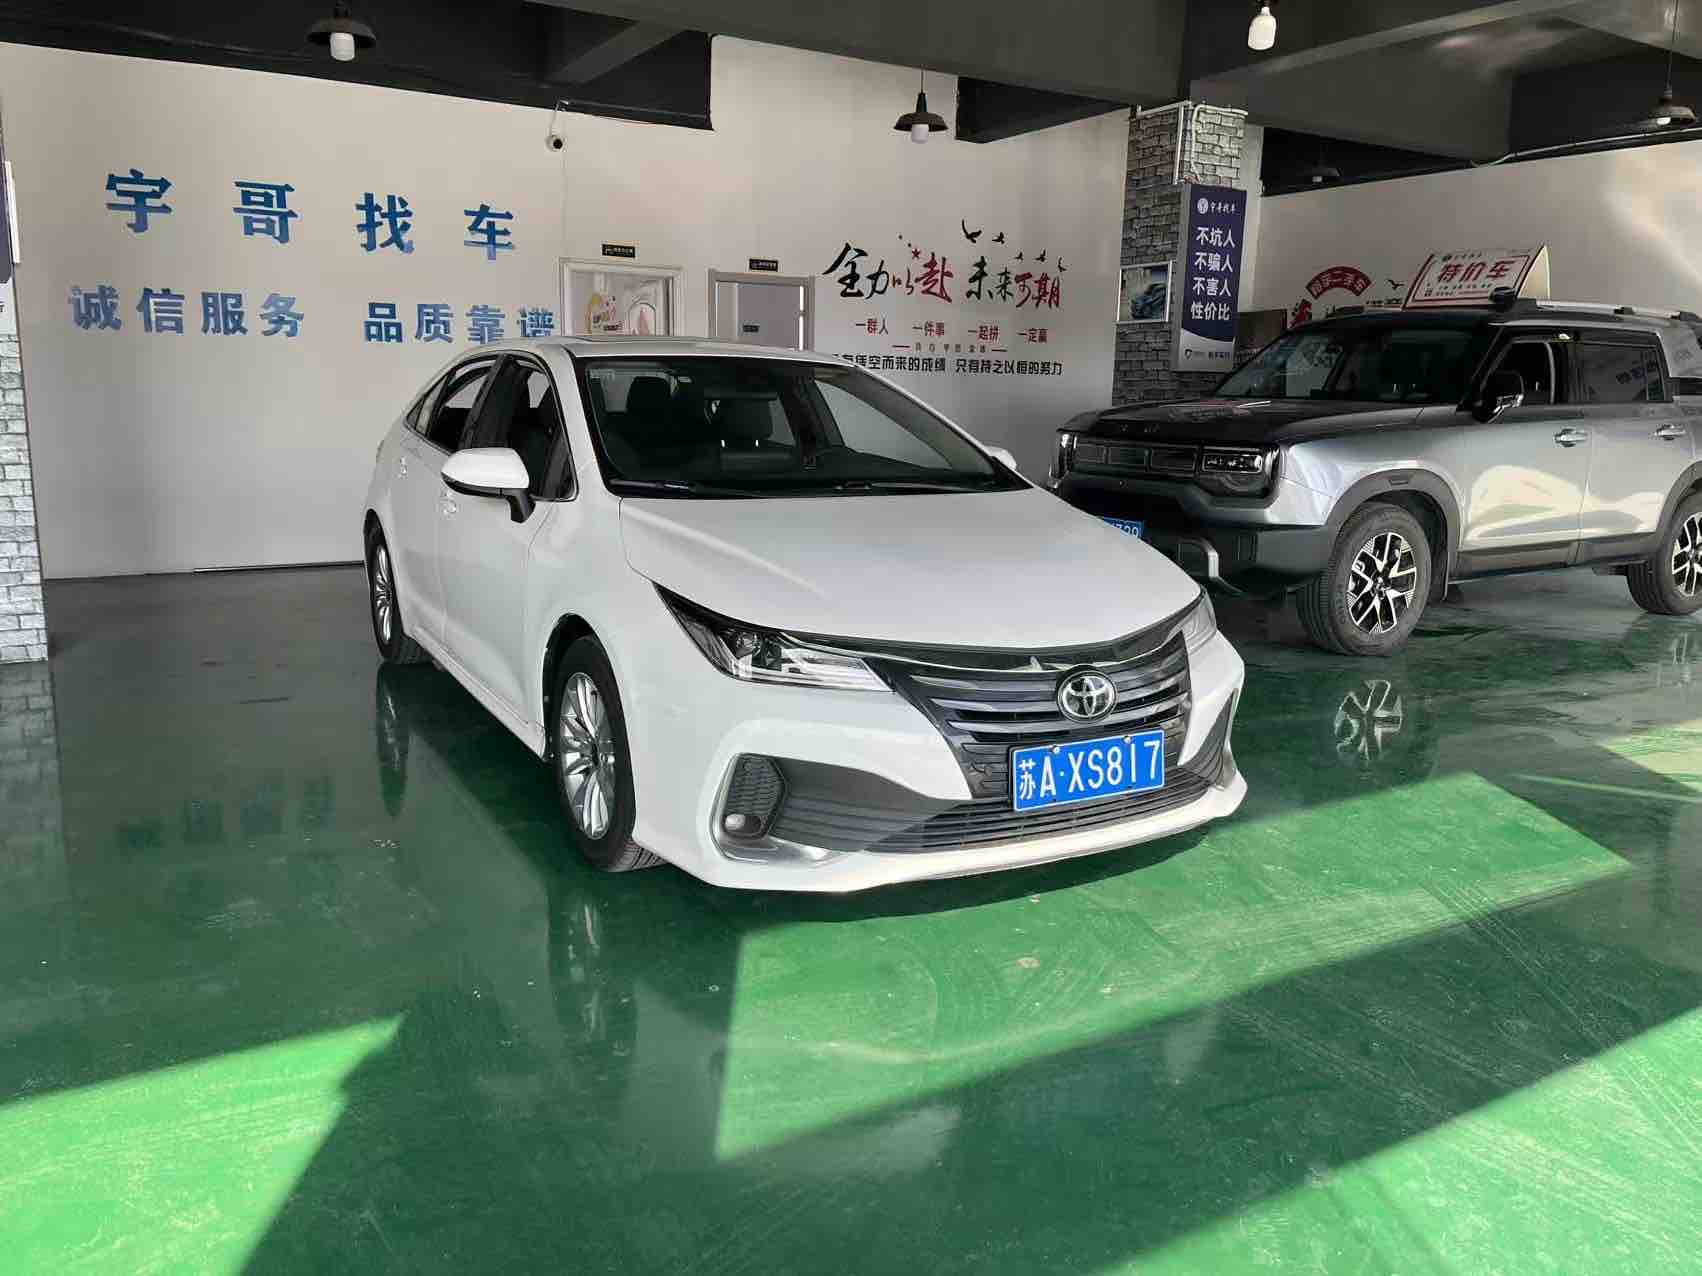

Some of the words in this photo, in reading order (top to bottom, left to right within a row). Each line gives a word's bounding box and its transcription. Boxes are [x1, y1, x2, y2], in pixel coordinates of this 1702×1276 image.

[106, 169, 515, 260] 宇哥找车
[1196, 226, 1236, 248] 不坑人
[1194, 251, 1234, 273] 不骗人
[1438, 260, 1516, 282] 特价车
[822, 243, 954, 303] 全力以赴
[966, 256, 1061, 309] 未来可期
[1192, 276, 1232, 298] 不害人
[68, 285, 305, 338] 诚信服务
[364, 303, 560, 344] 品质靠谱
[1190, 301, 1231, 321] 性价比
[856, 318, 889, 335] 一群人
[912, 321, 945, 337] 一件事
[968, 325, 999, 341] 一起拼
[1017, 328, 1049, 343] 一定赢
[956, 358, 1063, 376] 只有持之以恒的努力
